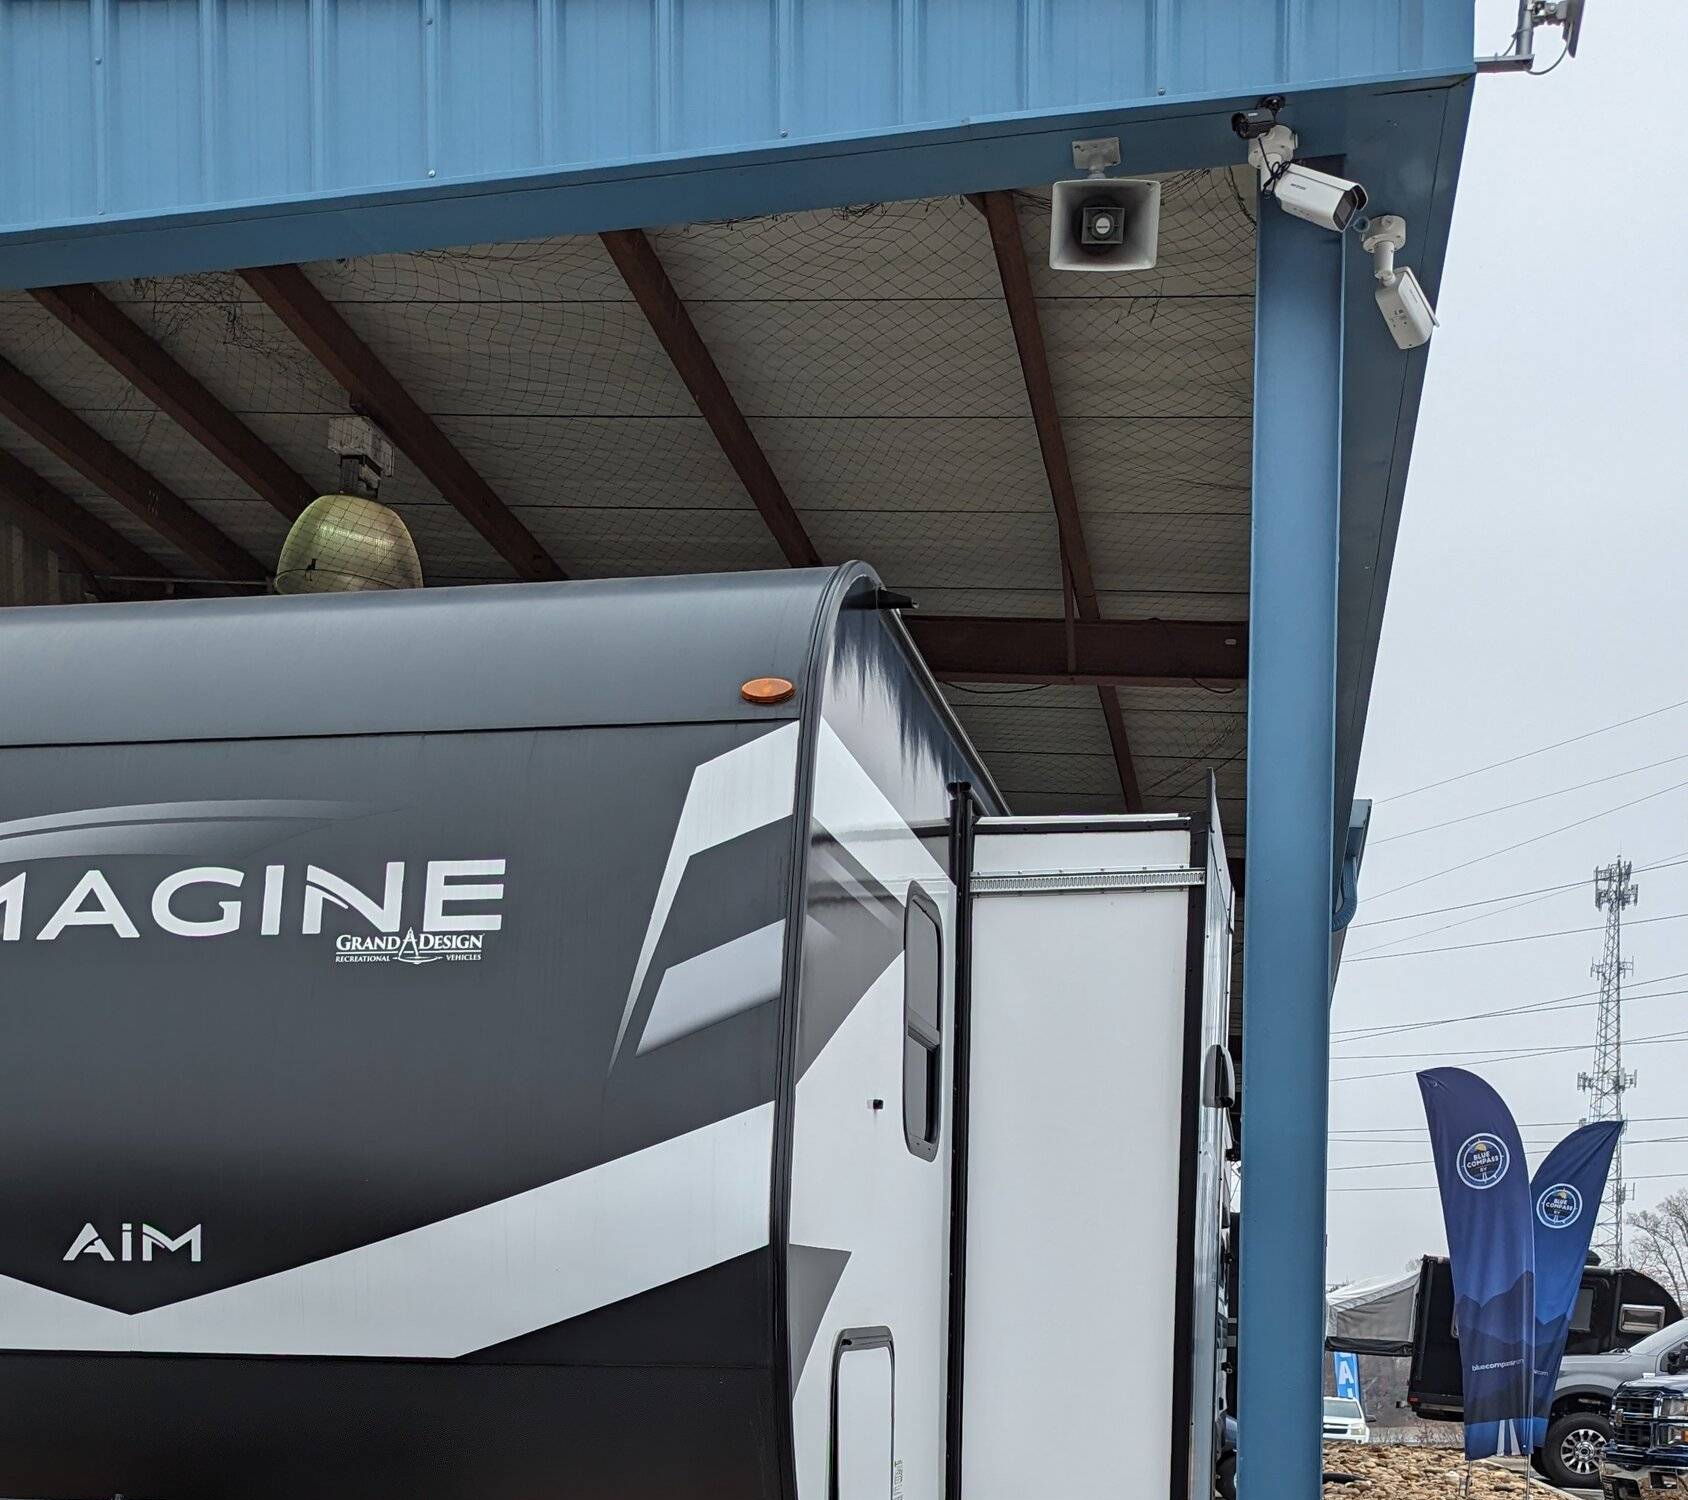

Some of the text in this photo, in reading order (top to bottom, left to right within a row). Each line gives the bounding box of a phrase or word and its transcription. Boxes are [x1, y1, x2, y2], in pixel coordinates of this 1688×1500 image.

[335, 933, 483, 951] GRAND DESIGN
[335, 953, 482, 963] RECREATIONAL VEHICLES
[1473, 1151, 1490, 1160] BLUE
[1466, 1155, 1499, 1168] COMPASS
